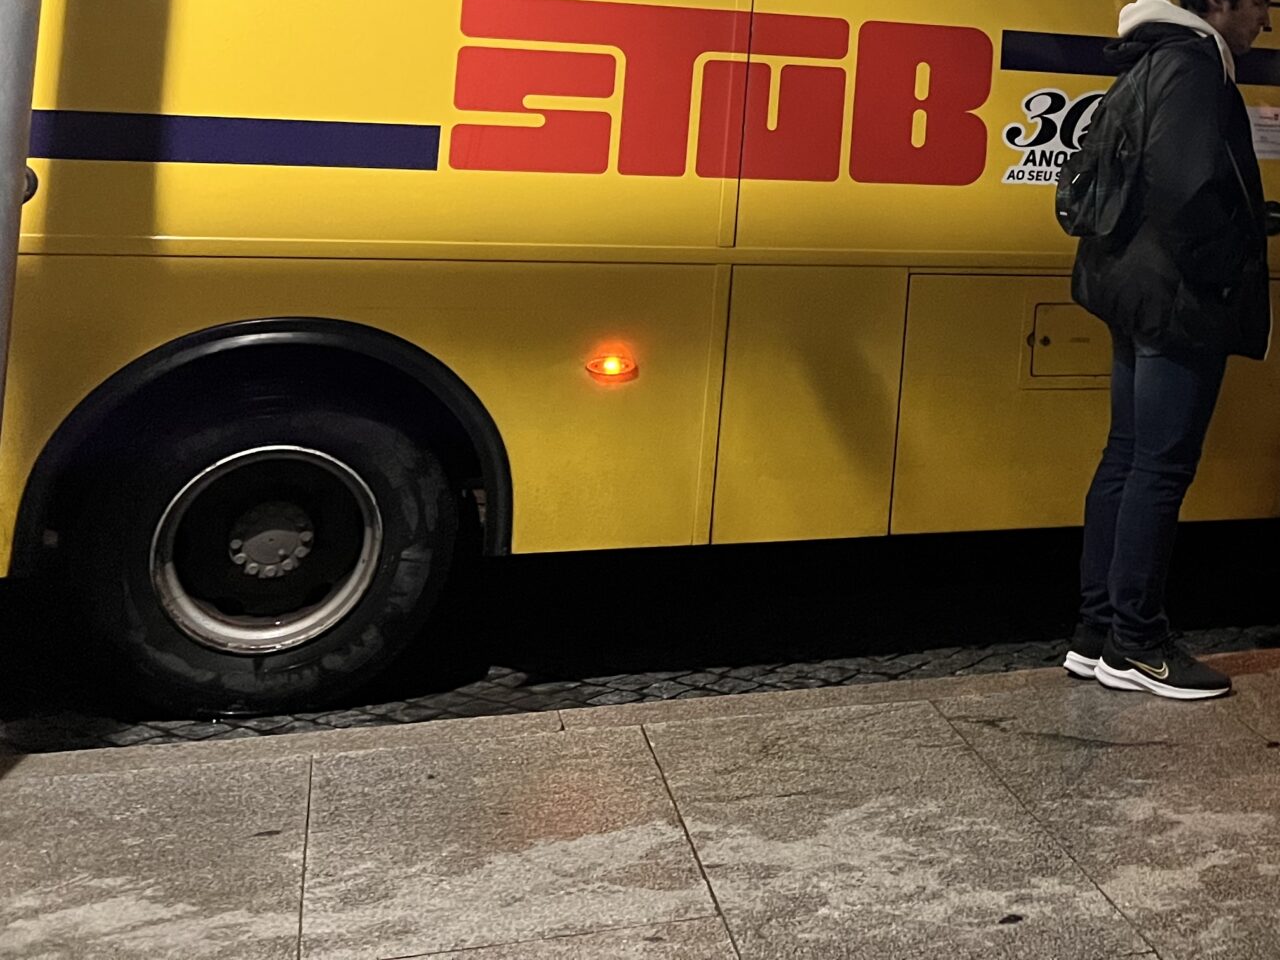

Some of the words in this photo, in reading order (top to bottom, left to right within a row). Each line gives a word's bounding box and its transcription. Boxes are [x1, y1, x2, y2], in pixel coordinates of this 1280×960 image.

[1023, 150, 1080, 167] ANO
[1007, 169, 1025, 180] AO
[1027, 170, 1052, 181] SEU
